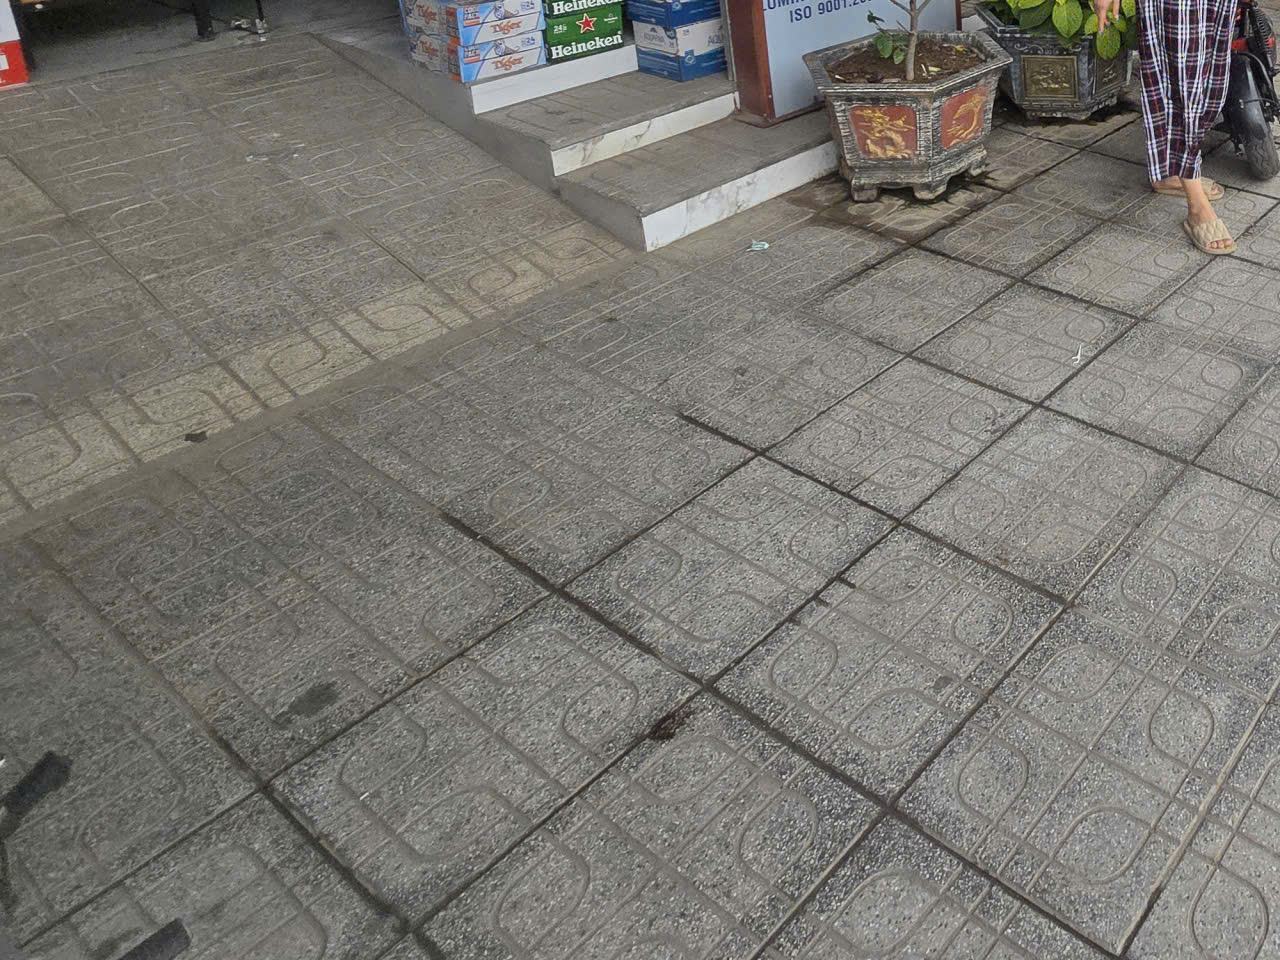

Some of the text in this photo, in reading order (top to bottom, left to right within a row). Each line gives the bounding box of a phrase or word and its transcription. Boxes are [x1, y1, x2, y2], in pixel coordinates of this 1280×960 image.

[789, 4, 812, 23] ISO
[491, 20, 522, 36] Tiger
[551, 31, 623, 60] Heineken
[492, 55, 524, 72] Tiger
